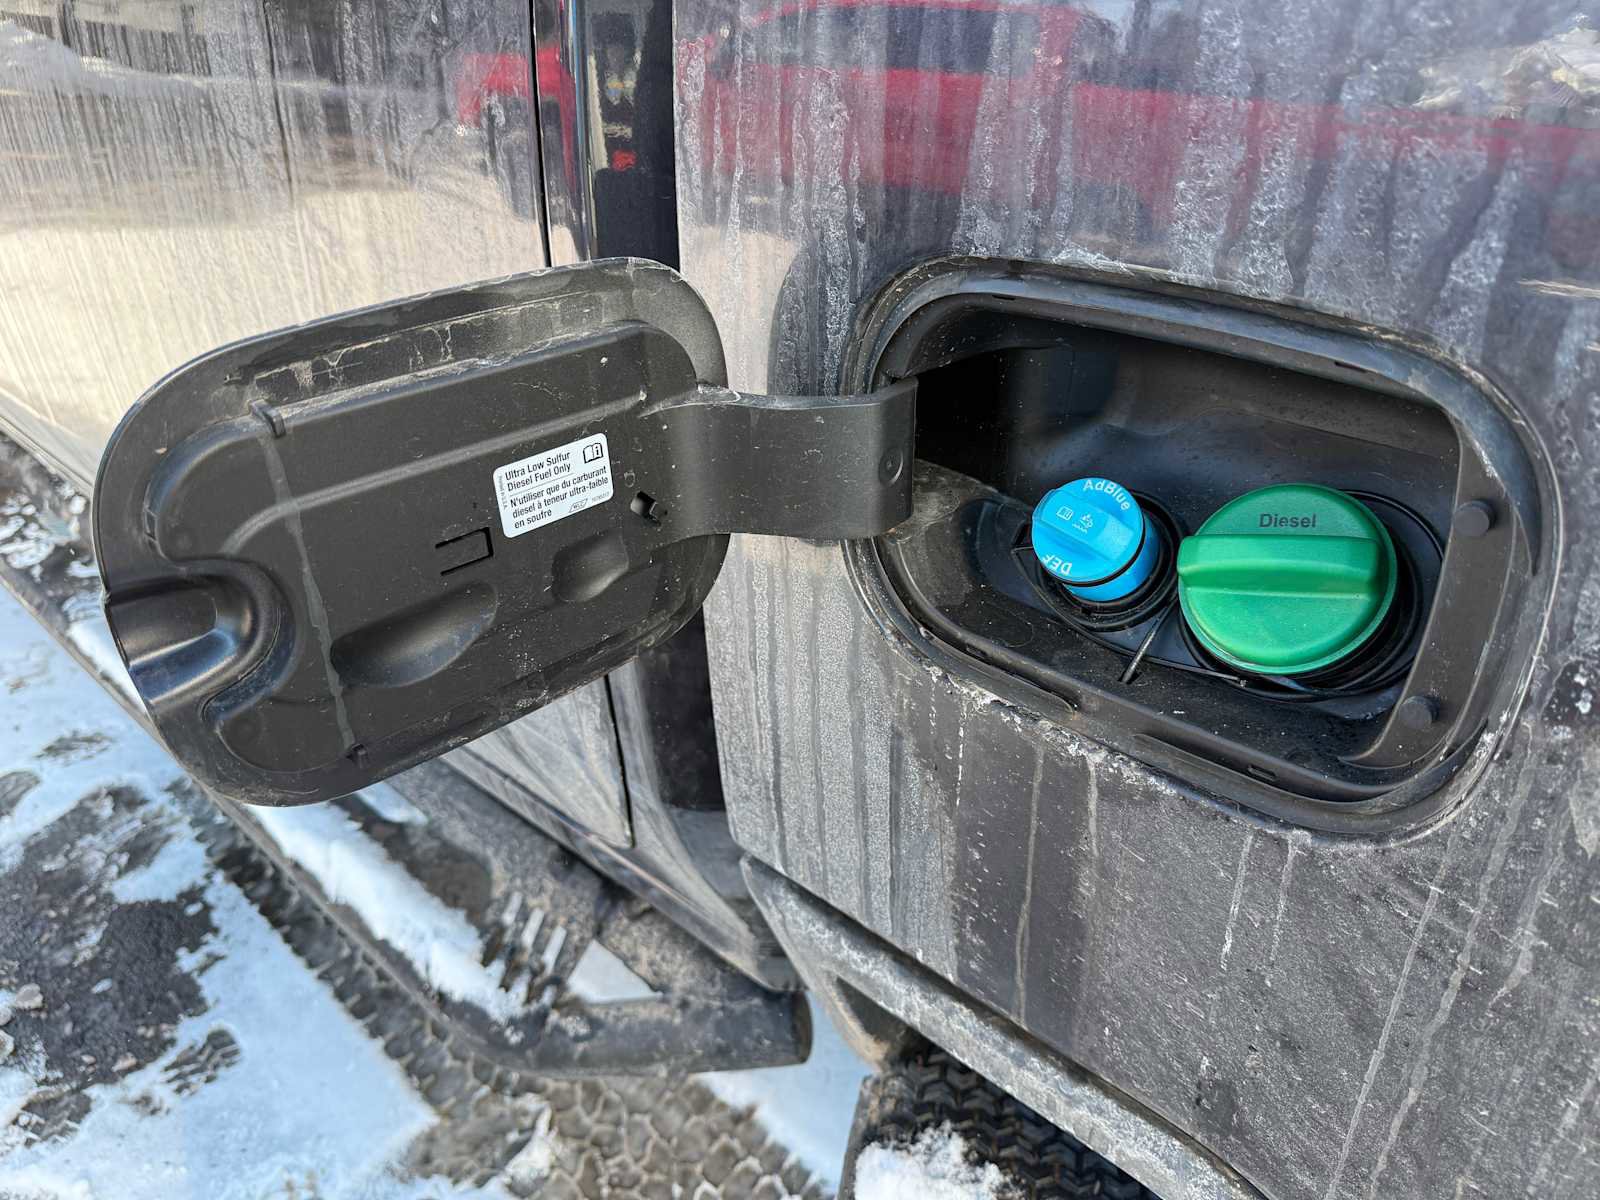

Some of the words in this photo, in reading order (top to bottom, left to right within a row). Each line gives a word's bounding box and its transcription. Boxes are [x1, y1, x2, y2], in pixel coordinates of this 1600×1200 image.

[505, 468, 526, 481] Ultra
[527, 461, 544, 473] Low
[546, 452, 570, 466] Sulfur
[507, 476, 533, 491] Diesel
[534, 470, 552, 482] Fuel
[553, 463, 571, 475] Only
[510, 490, 544, 508] N'utiliser
[546, 484, 560, 496] que
[561, 479, 571, 489] du
[572, 466, 607, 485] carburant
[512, 504, 536, 519] diesel
[537, 500, 543, 510] à
[544, 491, 568, 507] teneur
[569, 476, 609, 497] ultra-faible
[1083, 479, 1131, 511] AdBlue
[514, 519, 525, 529] en
[527, 509, 552, 525] soufre
[1259, 512, 1316, 528] Diesel
[1042, 554, 1072, 575] DEF
